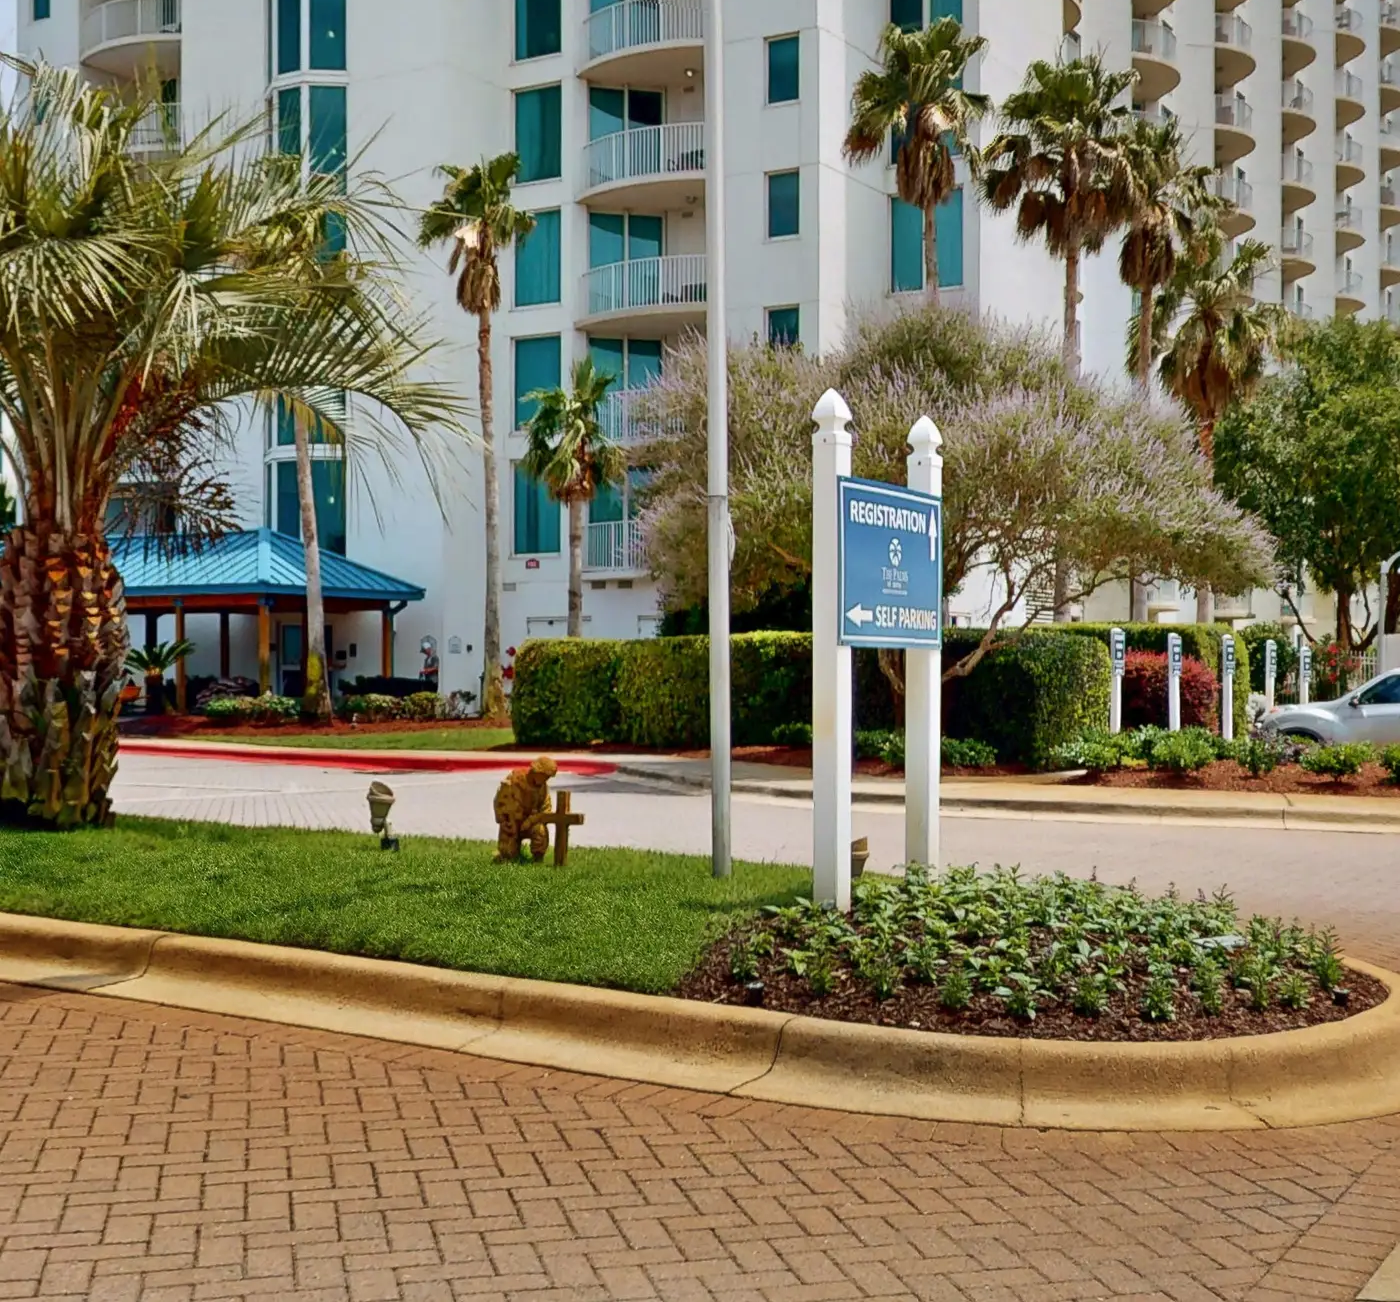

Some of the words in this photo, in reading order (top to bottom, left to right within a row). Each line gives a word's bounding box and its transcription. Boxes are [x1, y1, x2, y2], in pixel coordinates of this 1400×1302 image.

[850, 500, 926, 534] REGISTRATION
[875, 605, 897, 628] SELF
[898, 607, 937, 631] PARKING
